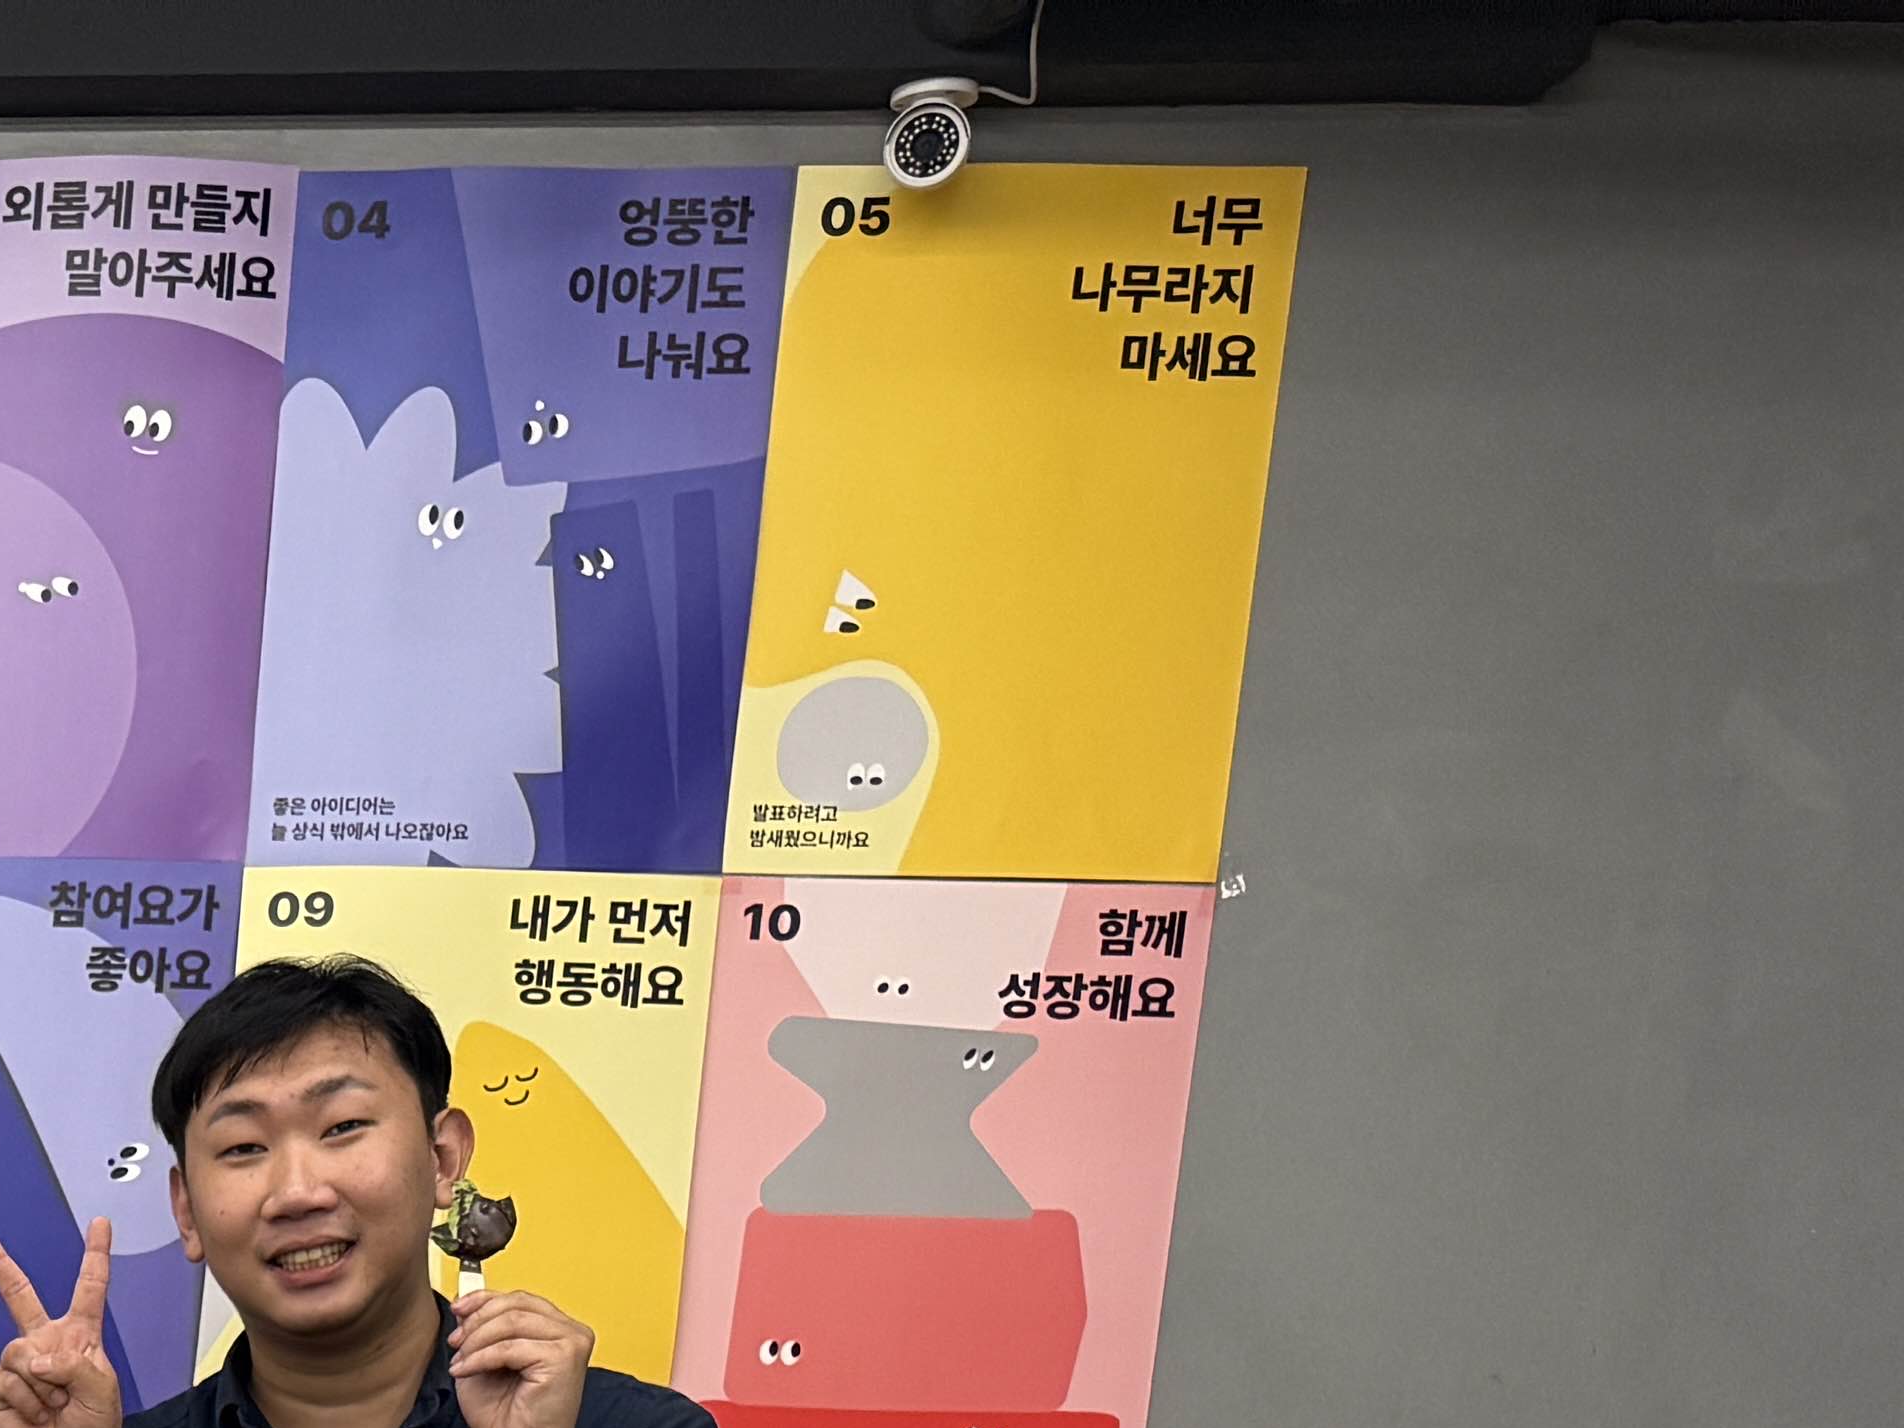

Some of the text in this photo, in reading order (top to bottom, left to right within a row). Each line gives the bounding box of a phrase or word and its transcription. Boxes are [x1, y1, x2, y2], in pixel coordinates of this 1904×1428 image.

[1, 181, 271, 237] 외롭게 만들지
[322, 199, 390, 239] 04
[620, 196, 754, 245] 엉뚱한
[821, 197, 892, 238] 05
[1172, 197, 1263, 245] 너무
[64, 248, 277, 300] 말아주세요
[569, 265, 747, 314] 이야기도
[1071, 264, 1252, 316] 나무라지
[617, 332, 750, 381] 나눠요
[1121, 334, 1256, 382] 마세요
[311, 797, 396, 815] 아이디어는
[753, 804, 838, 822] 발표하려고
[292, 823, 324, 840] 상식
[49, 883, 219, 931] 참여요가
[268, 892, 334, 927] 09
[511, 897, 690, 947] 내가 먼저
[743, 904, 801, 942] 10
[1099, 910, 1185, 959] 함께
[86, 948, 211, 993] 좋아요
[515, 963, 684, 1009] 행동해요
[1000, 973, 1176, 1021] 성장해요
